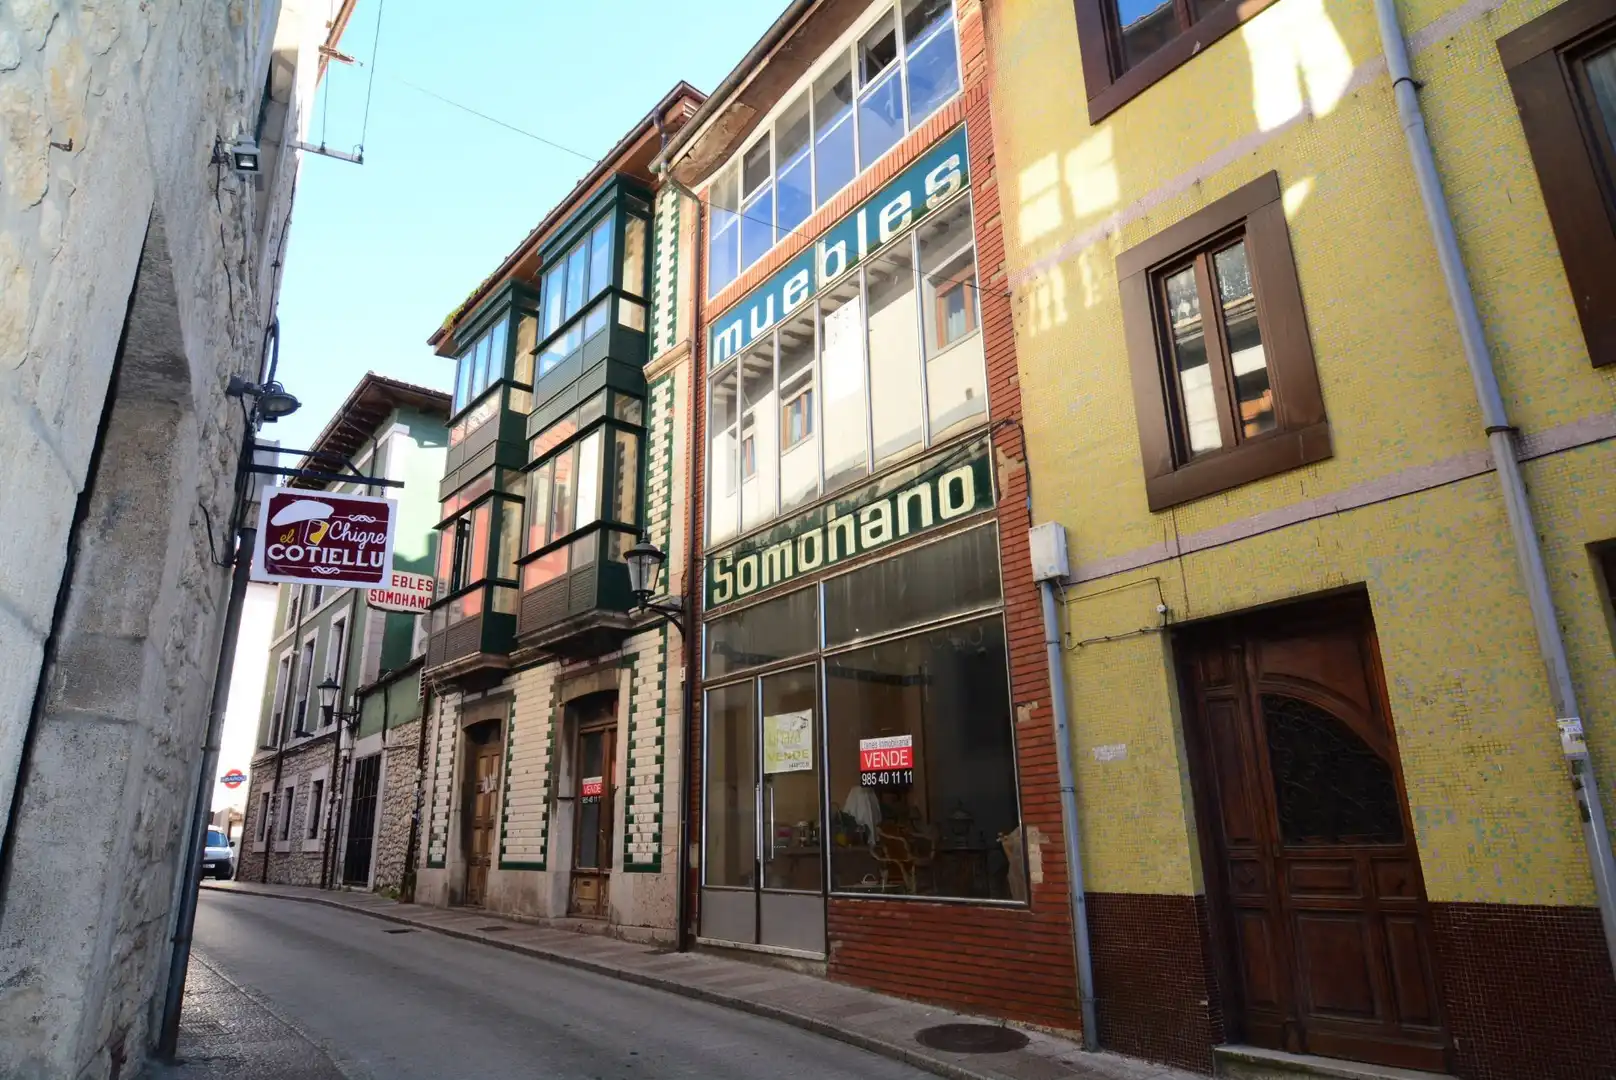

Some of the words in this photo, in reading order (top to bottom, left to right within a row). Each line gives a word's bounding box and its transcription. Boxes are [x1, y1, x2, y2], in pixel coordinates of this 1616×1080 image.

[712, 153, 962, 371] muebles
[280, 529, 294, 544] el
[328, 520, 387, 549] Chigre
[713, 464, 976, 605] Somohano
[267, 544, 385, 567] COTIELLU
[391, 575, 433, 592] EBLES
[370, 589, 432, 609] SOMOHANO
[864, 749, 909, 768] VENDE
[861, 772, 877, 785] 985
[878, 771, 889, 784] 40
[891, 771, 900, 784] 11
[904, 770, 913, 783] 11
